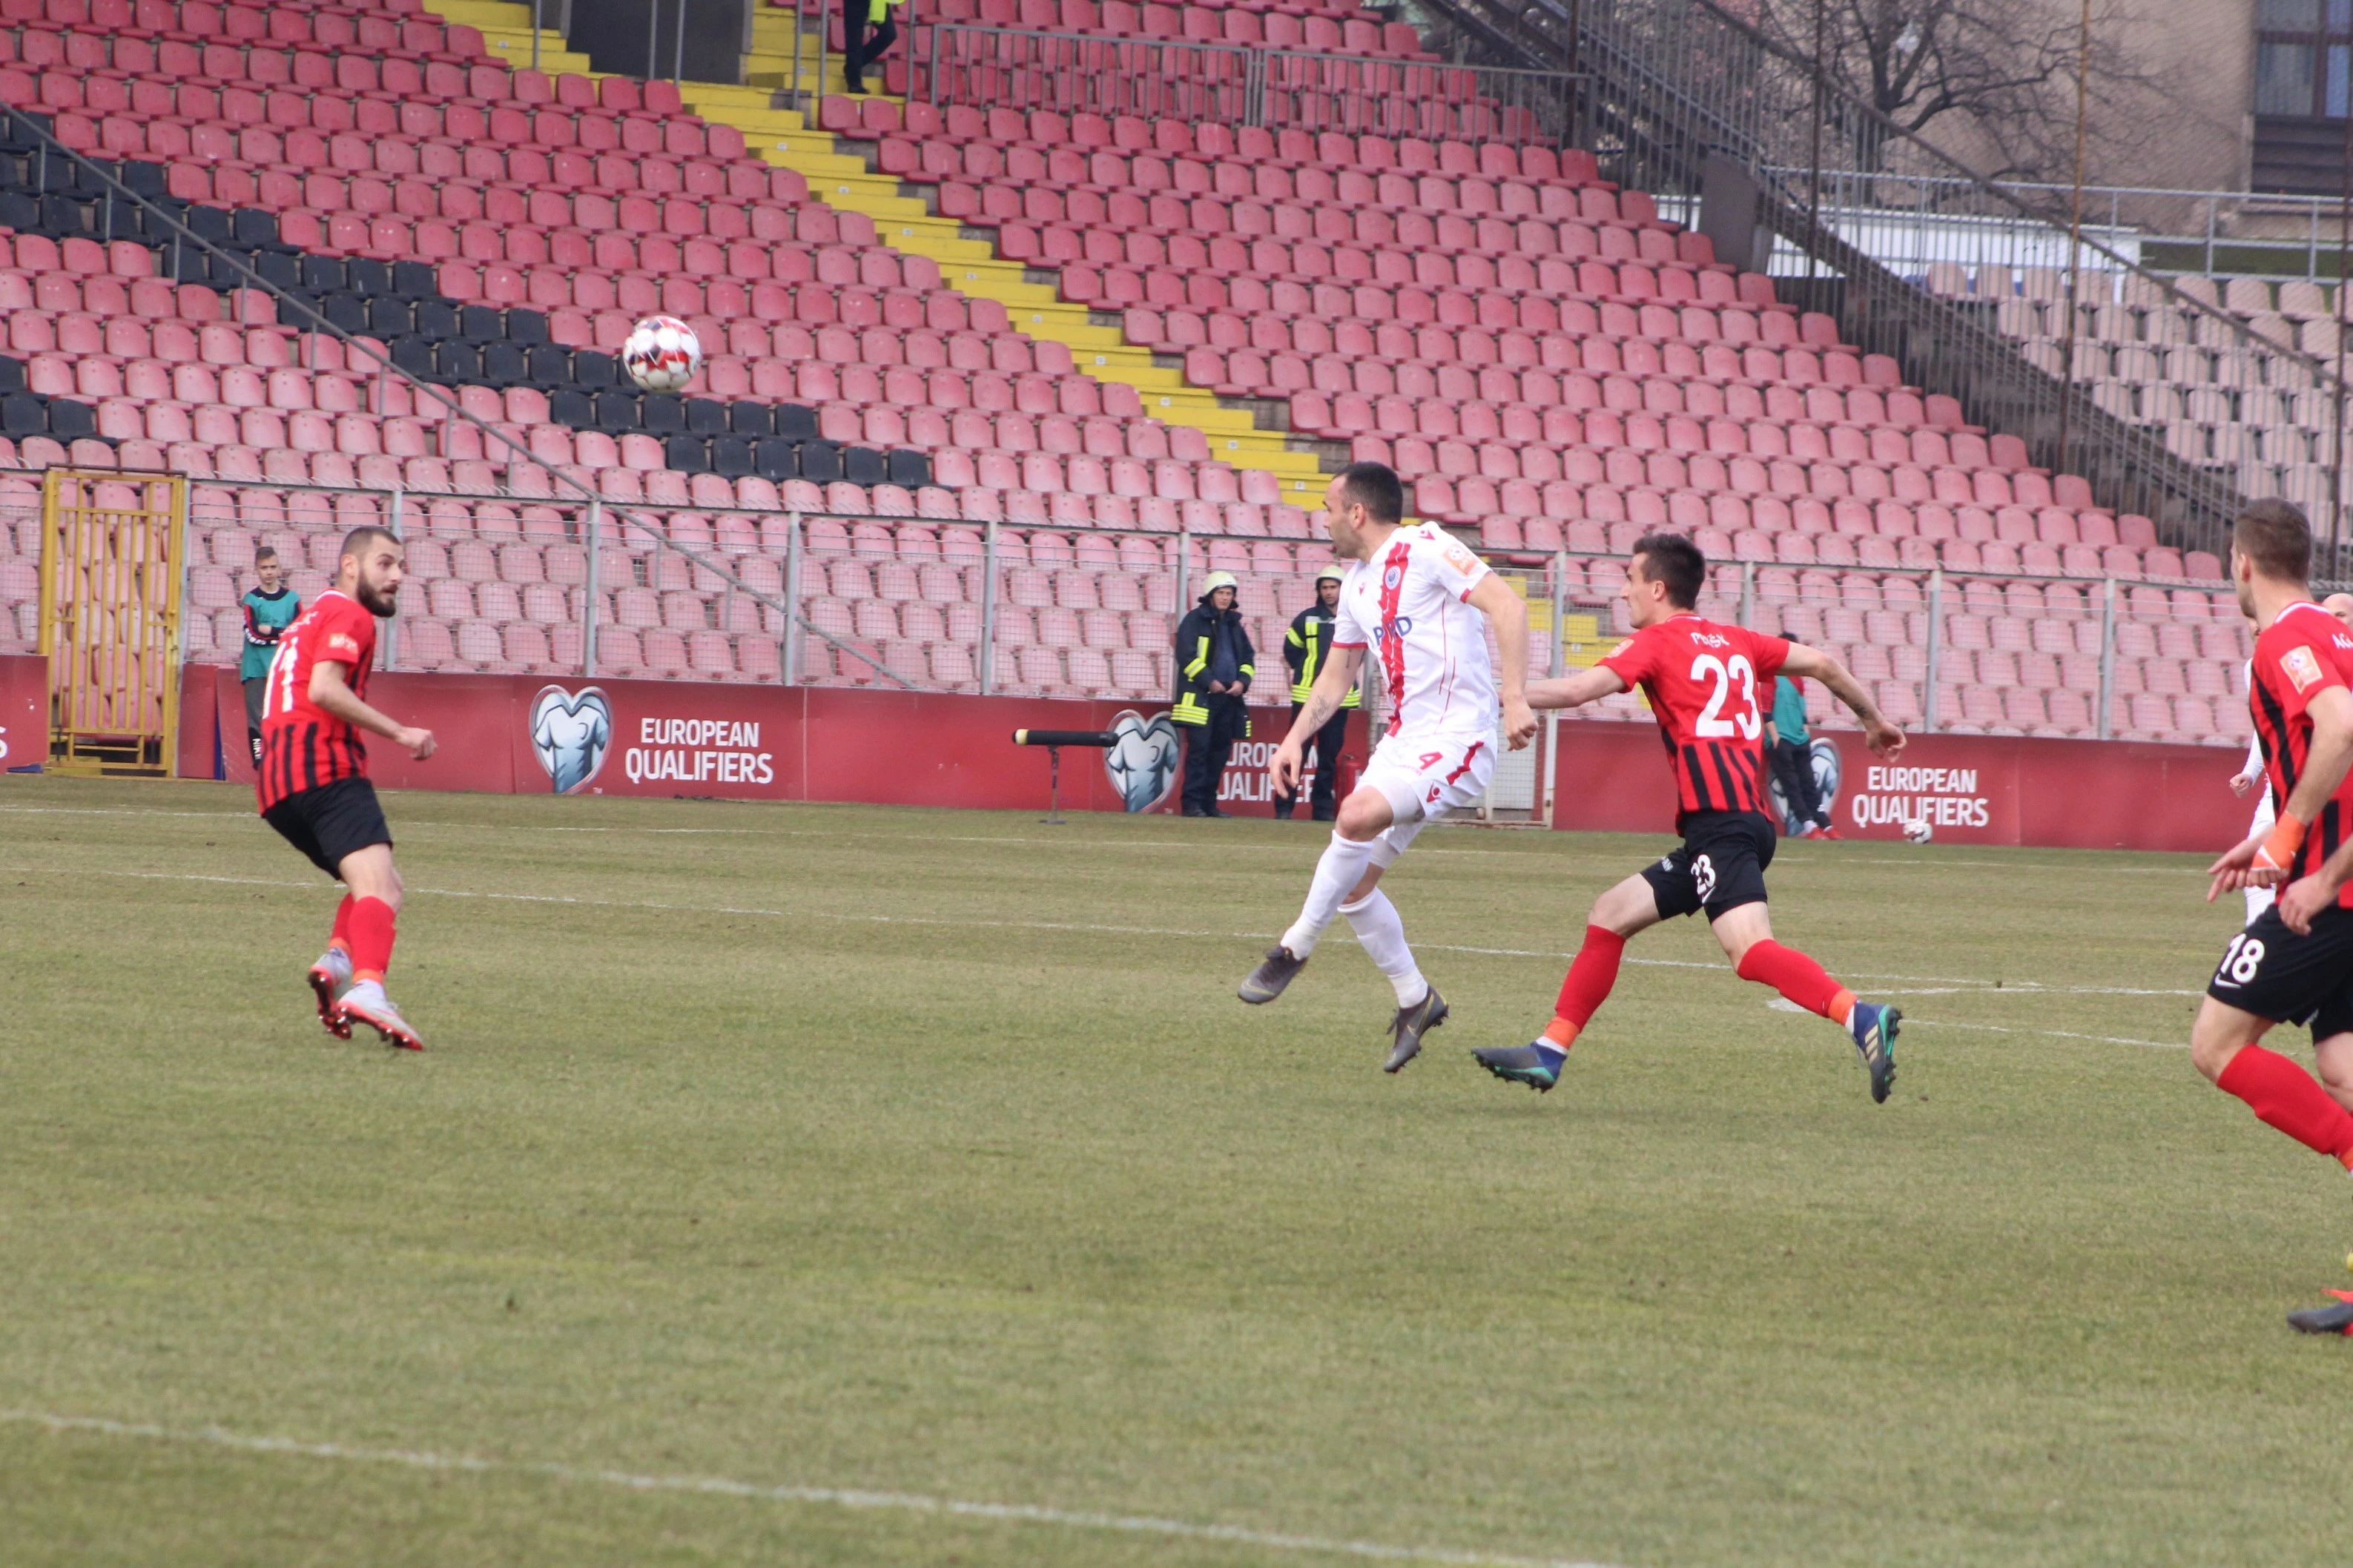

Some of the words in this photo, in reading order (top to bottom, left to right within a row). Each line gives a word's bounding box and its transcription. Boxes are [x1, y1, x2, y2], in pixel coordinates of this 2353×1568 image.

[1690, 653, 1761, 741] 23
[641, 717, 759, 747] EUROPEAN
[625, 747, 773, 784] QUALIFIERS
[1419, 751, 1443, 770] 4
[1868, 766, 1977, 793] EUROPEAN
[1852, 794, 1989, 828] QUALIFIERS
[1691, 854, 1716, 895] 23
[2220, 933, 2265, 984] 18
